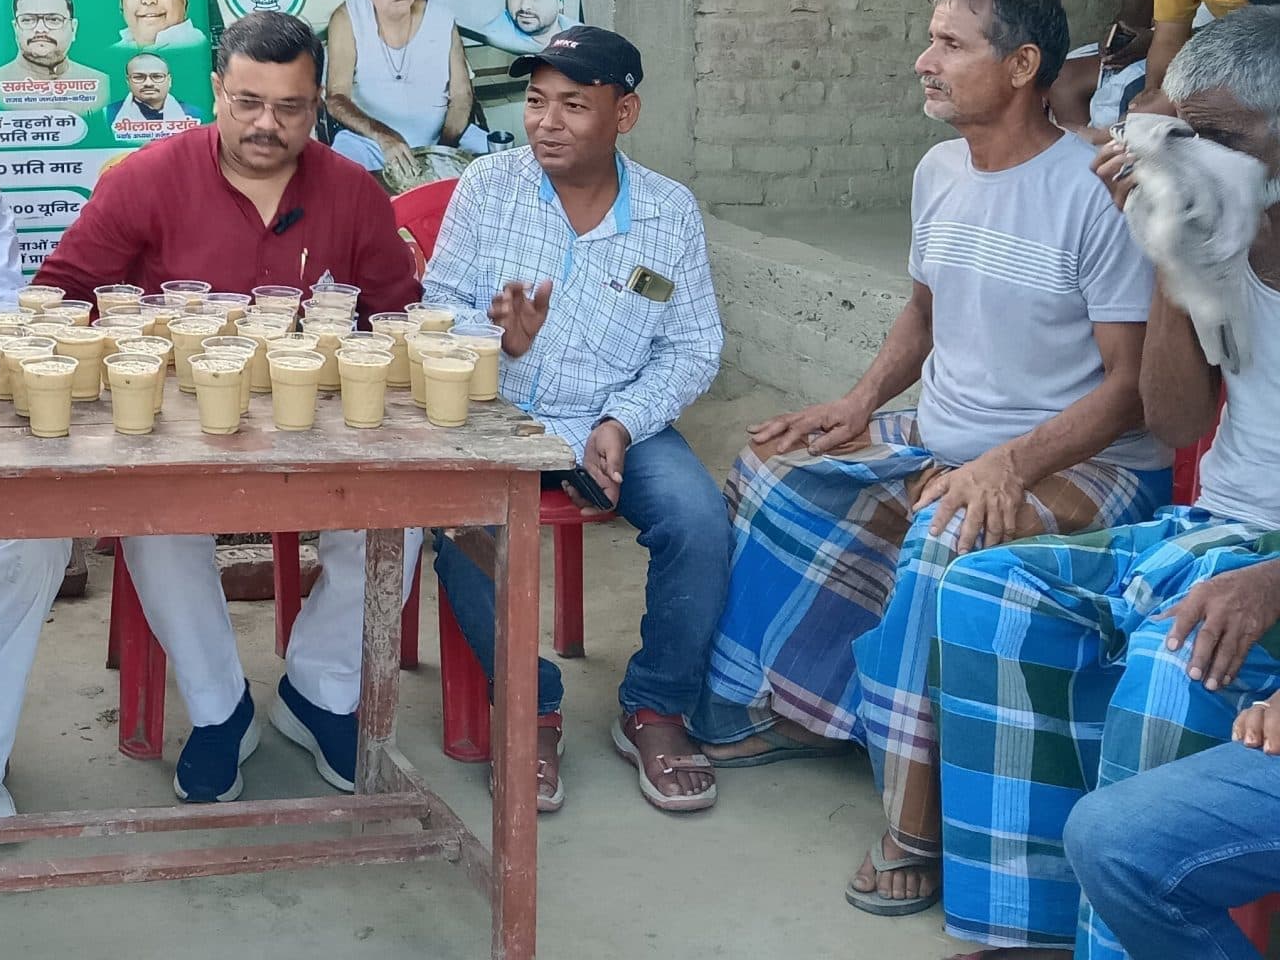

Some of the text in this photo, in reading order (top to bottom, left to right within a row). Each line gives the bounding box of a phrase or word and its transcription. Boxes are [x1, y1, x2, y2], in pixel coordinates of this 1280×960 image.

[2, 78, 97, 94] समरेन्द्र कुणाल
[55, 114, 76, 128] को
[115, 118, 162, 131] श्रीलाल
[0, 129, 28, 143] प्रति
[31, 130, 60, 142] माह
[11, 159, 44, 175] प्रति
[49, 161, 84, 174] माह
[37, 200, 80, 217] यूनिट
